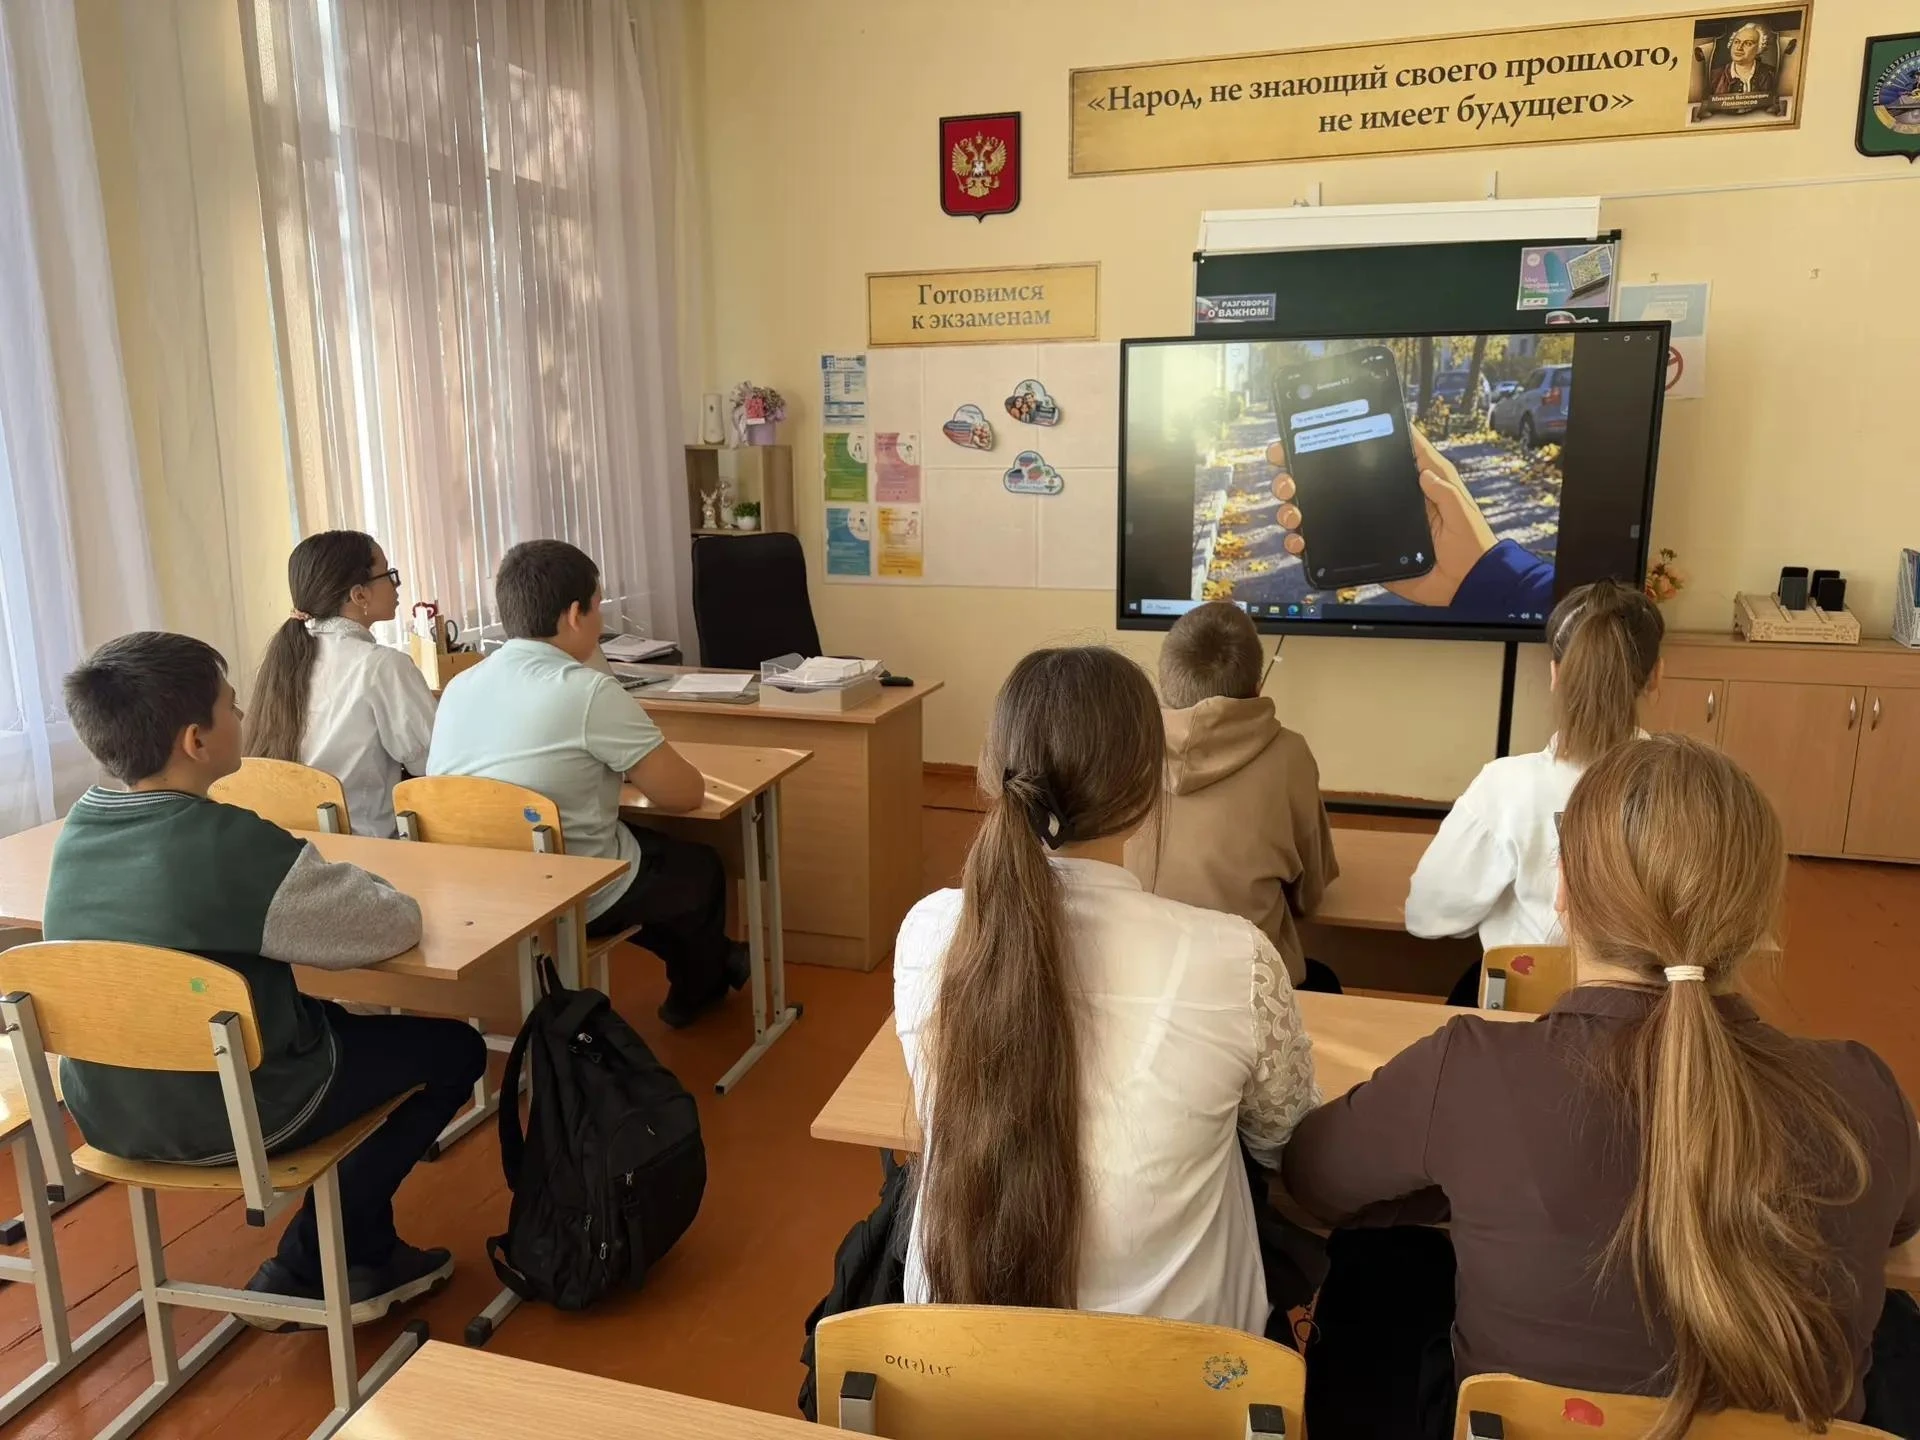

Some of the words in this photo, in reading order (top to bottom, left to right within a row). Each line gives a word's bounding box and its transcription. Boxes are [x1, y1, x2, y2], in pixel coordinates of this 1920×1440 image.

[1087, 84, 1202, 117] «Народ,
[1209, 82, 1243, 103] не
[1249, 64, 1389, 100] знающий
[1395, 60, 1498, 88] своего
[1505, 45, 1679, 86] прошлого,
[1721, 99, 1758, 107] Ломоносов
[1735, 93, 1769, 101] Васильевич
[1318, 112, 1354, 134] не
[1360, 104, 1450, 130] имеет
[1457, 93, 1635, 130] будущего»
[917, 284, 1045, 306] Готовимся
[1221, 299, 1270, 308] РАЗГОВОРЫ
[911, 314, 925, 330] к
[928, 309, 1051, 329] экзаменам
[1207, 309, 1216, 318] О
[1218, 307, 1270, 318] ВАЖНОМ!
